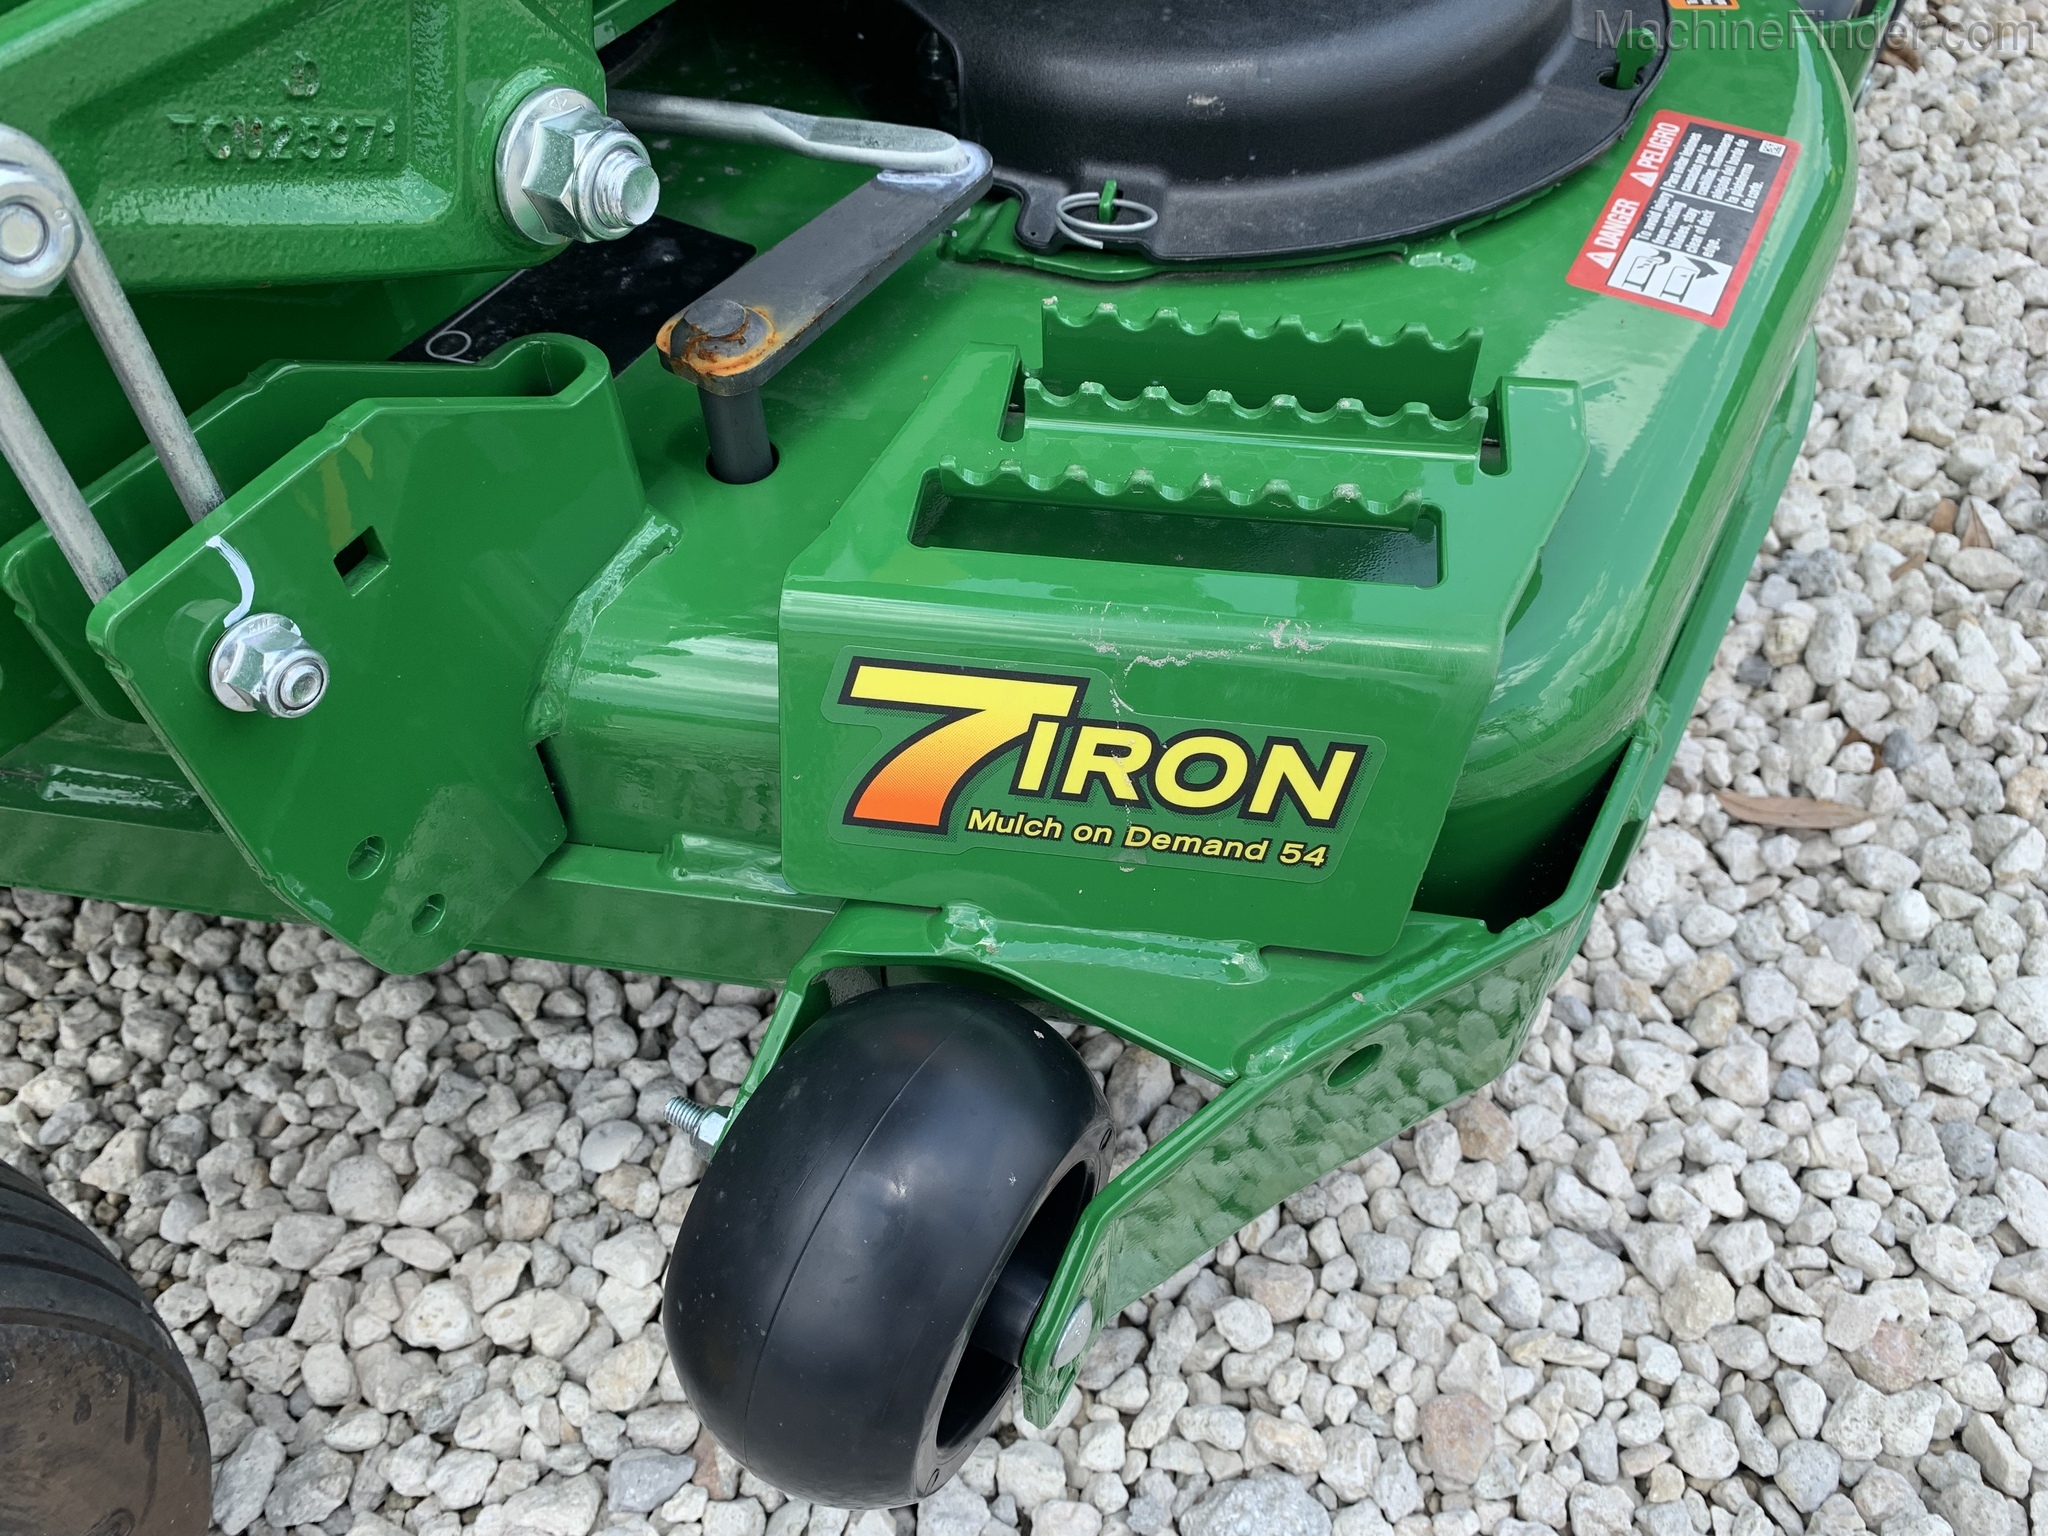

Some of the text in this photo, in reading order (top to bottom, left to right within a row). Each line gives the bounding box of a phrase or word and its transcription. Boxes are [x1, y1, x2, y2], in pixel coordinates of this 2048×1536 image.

[1636, 122, 1680, 170] PELIGRO
[1662, 132, 1702, 188] Para evitar lesiones
[1694, 152, 1708, 165] por
[1696, 143, 1713, 154] las
[1710, 138, 1748, 200] alejado del borde de
[1724, 195, 1739, 204] la
[1740, 181, 1764, 208] de corte.
[1593, 198, 1639, 249] DANGER
[1634, 230, 1652, 240] To
[1643, 209, 1662, 231] avoid
[1651, 227, 1671, 245] from
[1684, 209, 1715, 253] clear of deck
[1701, 237, 1721, 258] edge.
[966, 808, 1327, 868] Mulch on Demand 54
